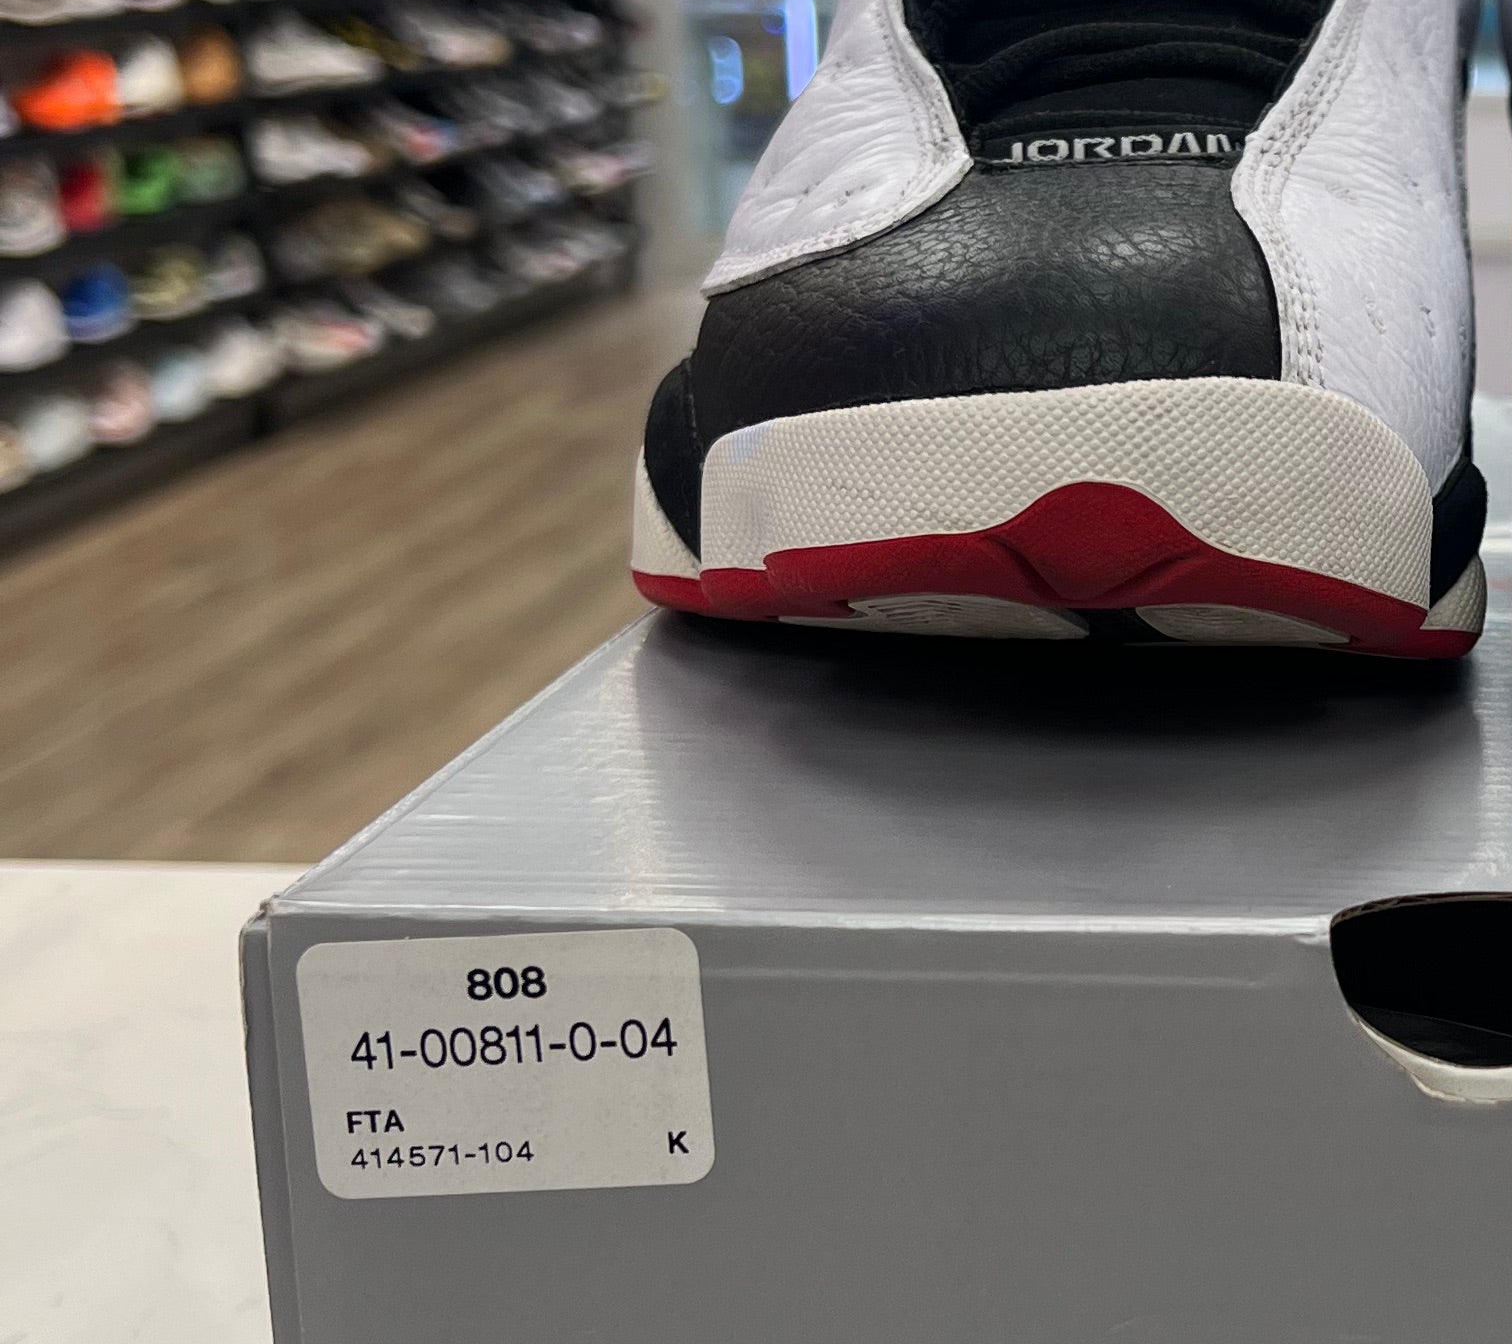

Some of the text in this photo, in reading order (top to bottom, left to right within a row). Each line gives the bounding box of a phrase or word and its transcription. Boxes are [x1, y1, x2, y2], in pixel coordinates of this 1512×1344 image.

[467, 966, 547, 1000] 808
[351, 1018, 678, 1069] 41-00811-0-04
[347, 1109, 405, 1133] FTA
[351, 1141, 535, 1170] 414571-104
[667, 1131, 690, 1154] K
